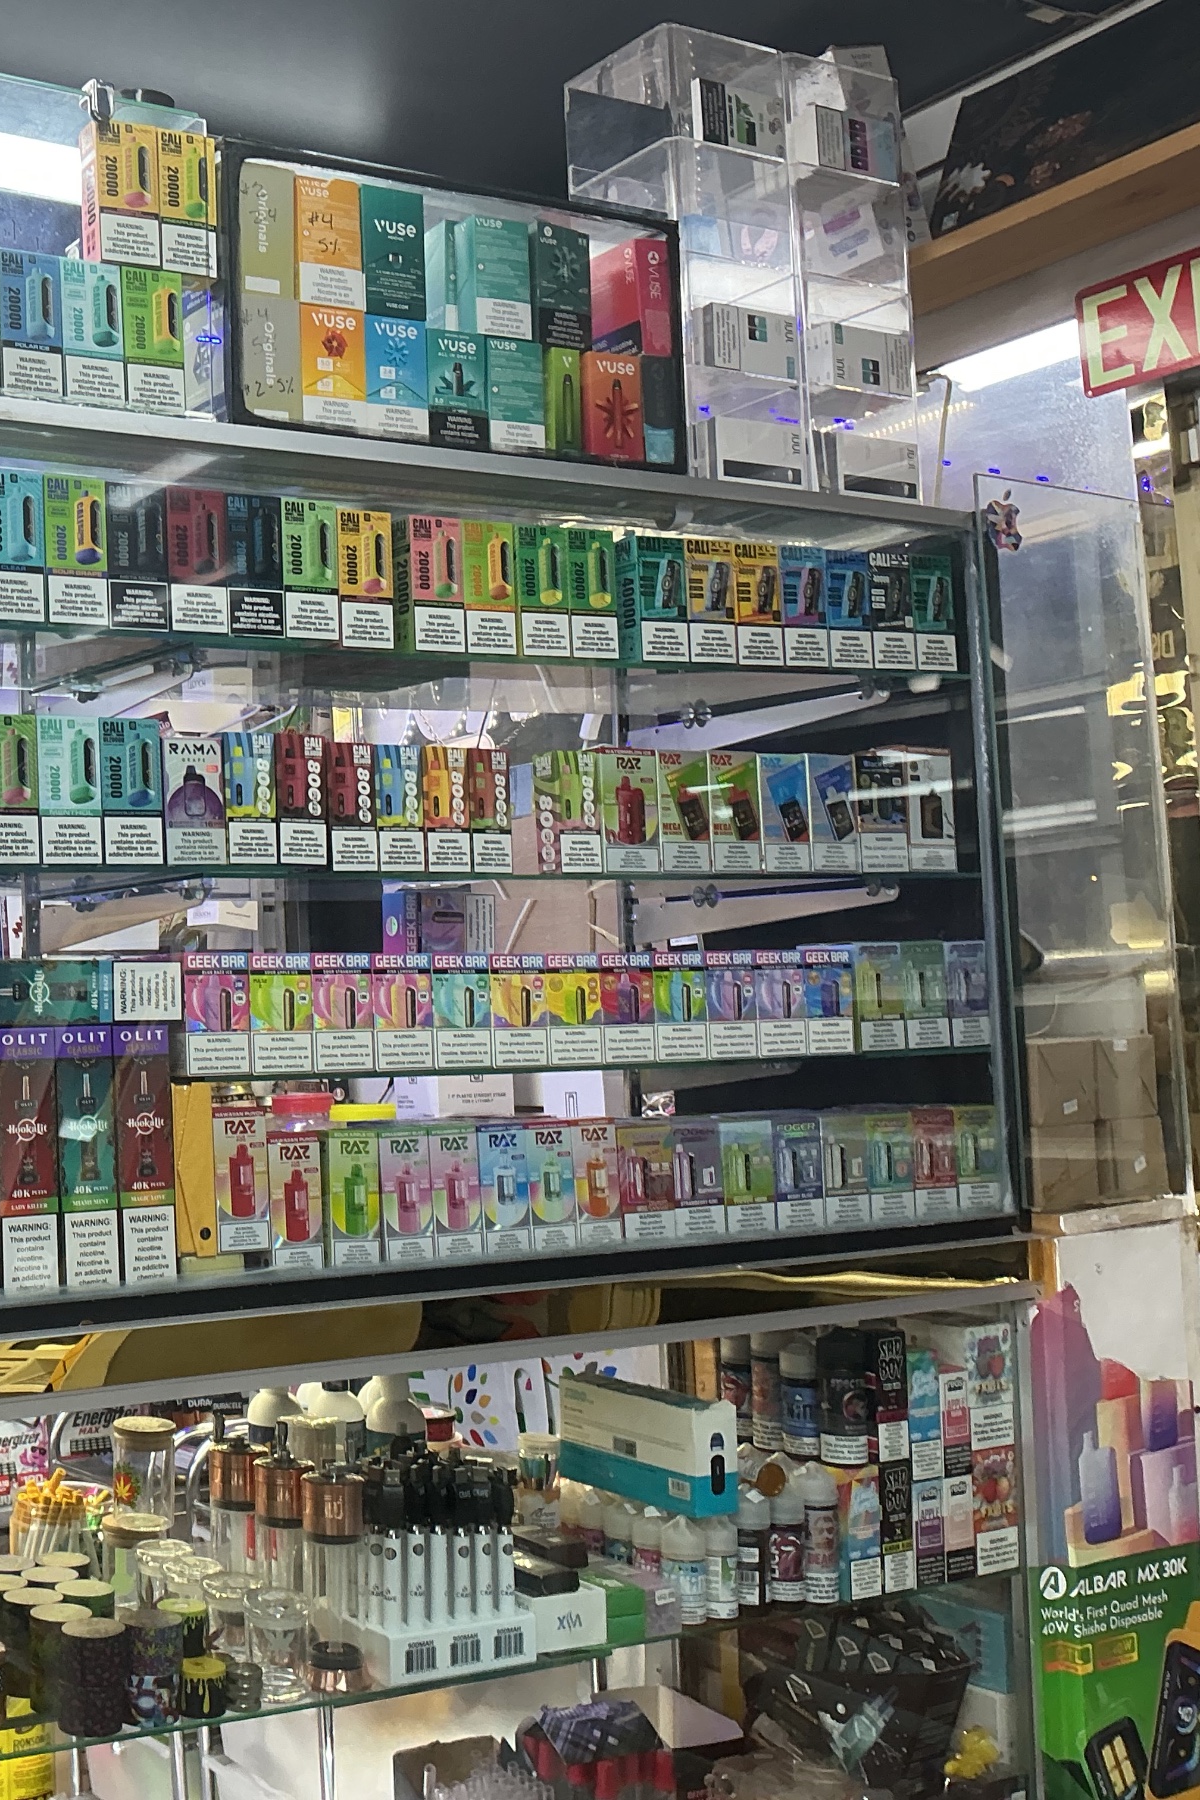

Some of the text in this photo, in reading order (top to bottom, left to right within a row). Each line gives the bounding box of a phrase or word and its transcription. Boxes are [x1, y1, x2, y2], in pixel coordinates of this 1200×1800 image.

[257, 188, 269, 254] Originals
[308, 211, 334, 230] #4
[647, 266, 663, 300] VUSE
[784, 320, 794, 343] JUUL
[264, 321, 276, 386] Originals
[836, 357, 846, 379] JUUL
[687, 540, 709, 554] CALI
[76, 570, 102, 578] GRAPE
[624, 578, 636, 630] 40000
[169, 743, 217, 756] RAMA
[187, 956, 246, 969] GEEK BAR
[252, 956, 310, 969] GEEK BAR
[314, 955, 370, 968] GEEK BAR
[374, 956, 430, 968] GEEK BAR
[434, 956, 487, 968] GEEK BAR
[119, 968, 127, 1015] WARNING:
[224, 1120, 256, 1136] RAZ
[340, 1140, 370, 1155] RAZ
[488, 1133, 517, 1148] RAZ
[280, 1144, 311, 1161] RAZ
[11, 1204, 27, 1212] LADY
[1069, 1556, 1188, 1597] ALBAR MX 30K
[1041, 1589, 1169, 1622] World's First Quad Mesh
[1042, 1606, 1163, 1638] 40W Shisha Disposable
